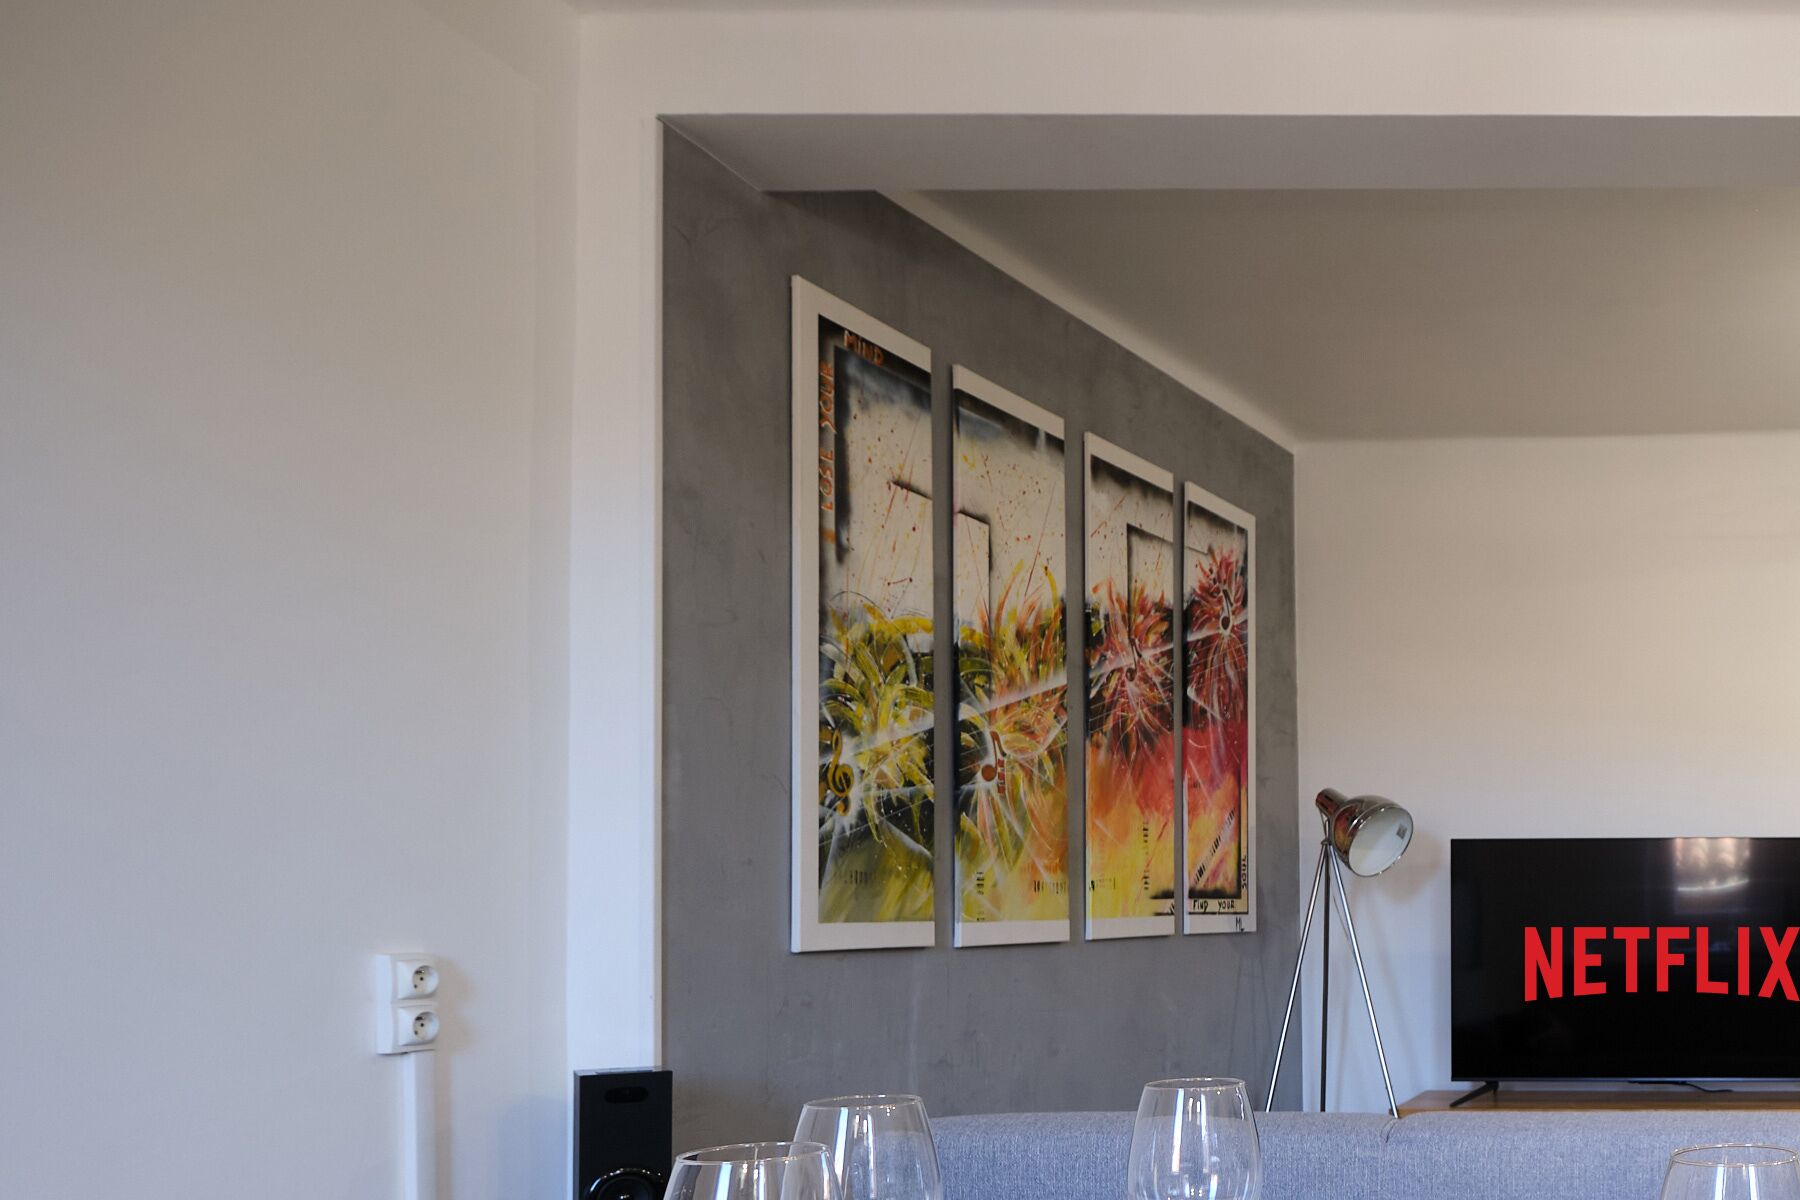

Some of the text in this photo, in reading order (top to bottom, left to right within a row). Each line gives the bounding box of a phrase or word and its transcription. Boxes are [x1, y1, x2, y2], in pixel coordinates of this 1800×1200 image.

[819, 329, 884, 511] LOSE YOUR MIND
[1217, 899, 1235, 912] YOUR
[1240, 855, 1248, 890] SOUL
[1525, 927, 1800, 1001] NETFLIX
